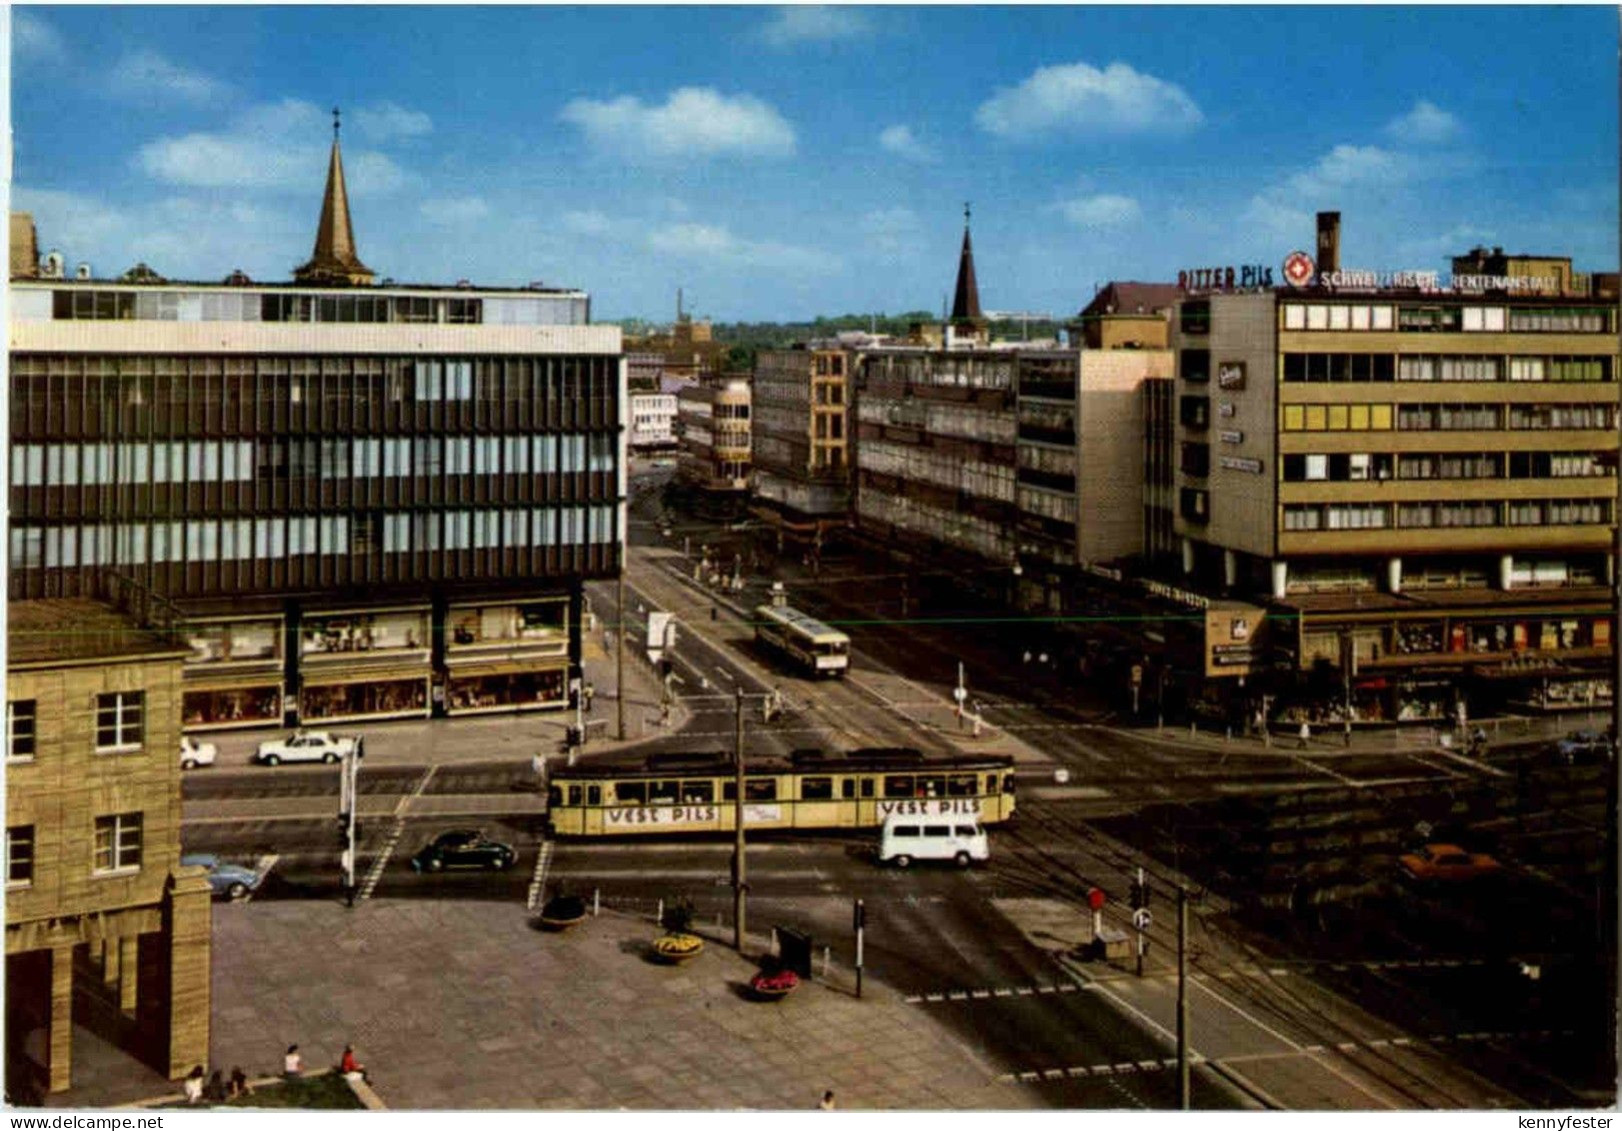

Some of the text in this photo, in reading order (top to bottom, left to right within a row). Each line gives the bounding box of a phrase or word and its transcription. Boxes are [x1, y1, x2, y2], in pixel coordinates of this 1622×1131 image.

[1178, 267, 1235, 288] RITTER
[672, 806, 714, 822] PILS
[939, 798, 980, 814] PILS
